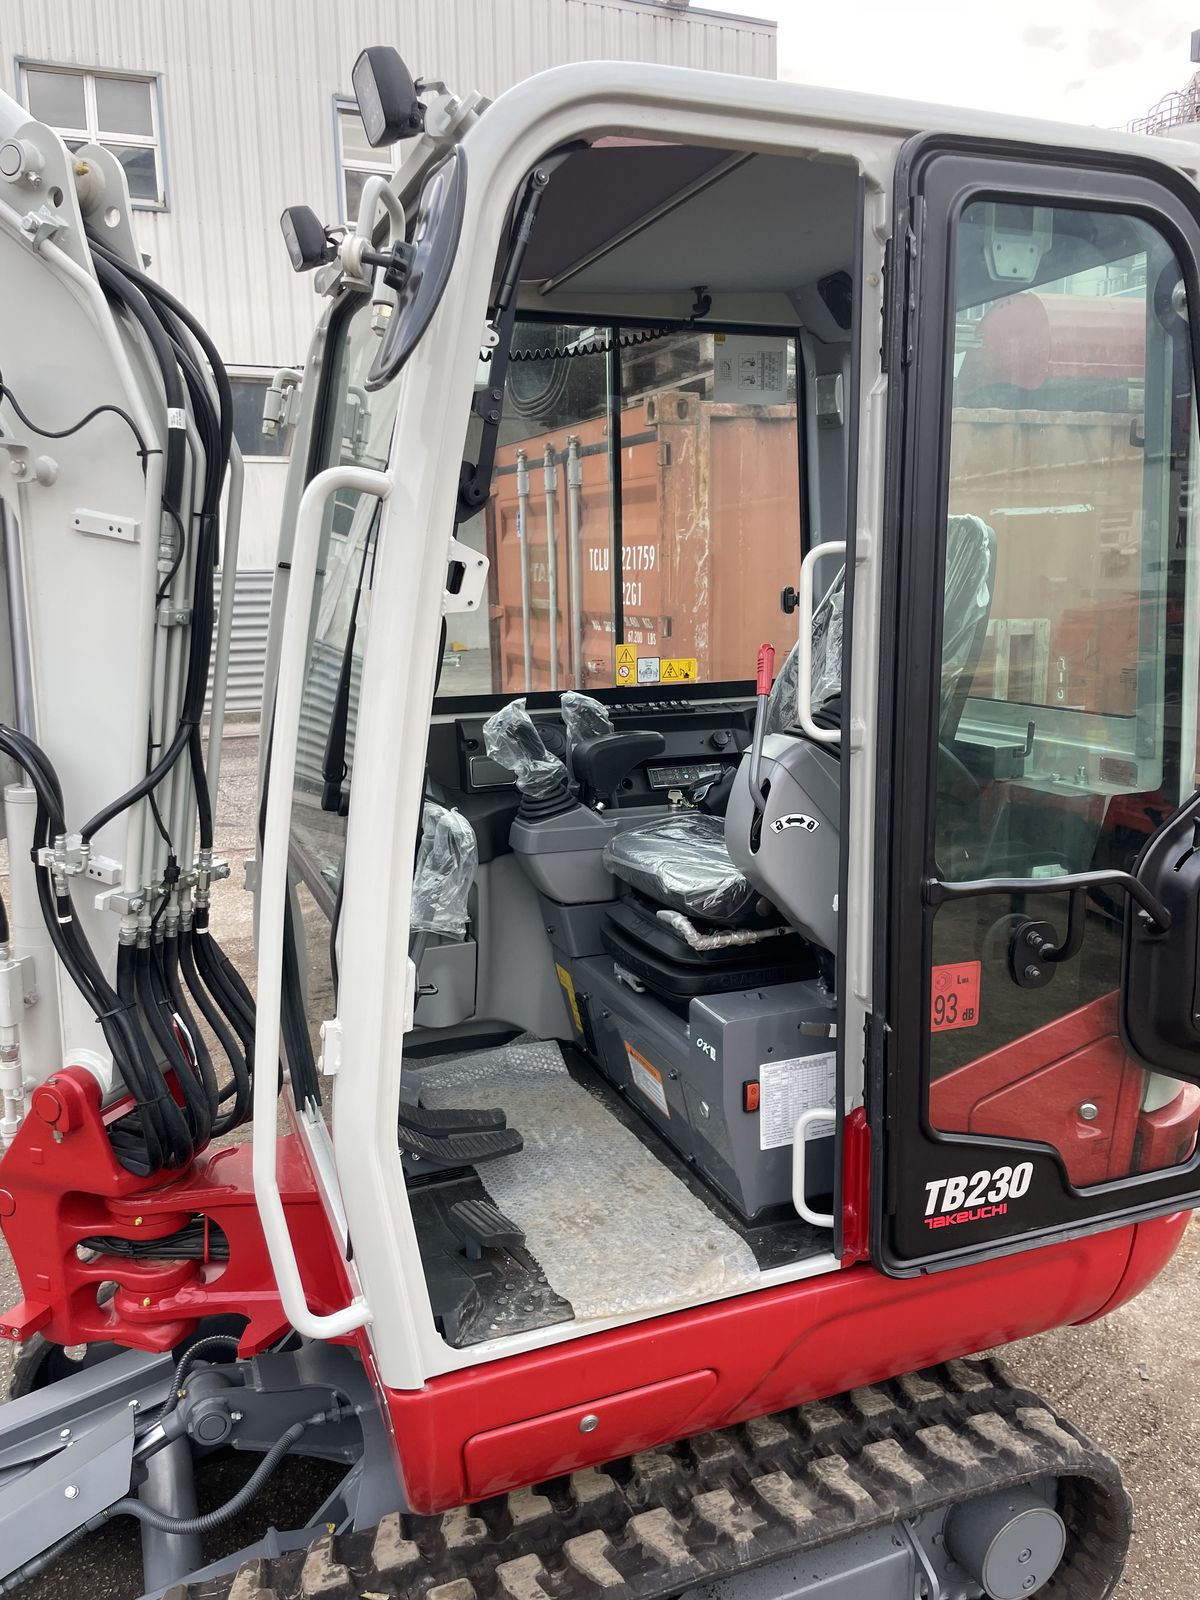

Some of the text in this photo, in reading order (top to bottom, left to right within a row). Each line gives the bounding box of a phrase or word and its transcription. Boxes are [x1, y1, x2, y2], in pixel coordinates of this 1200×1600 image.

[589, 547, 609, 571] TCLU
[933, 992, 975, 1026] 93 dB
[924, 1161, 1034, 1216] TB230
[923, 1203, 1008, 1229] TAKEUCHI
